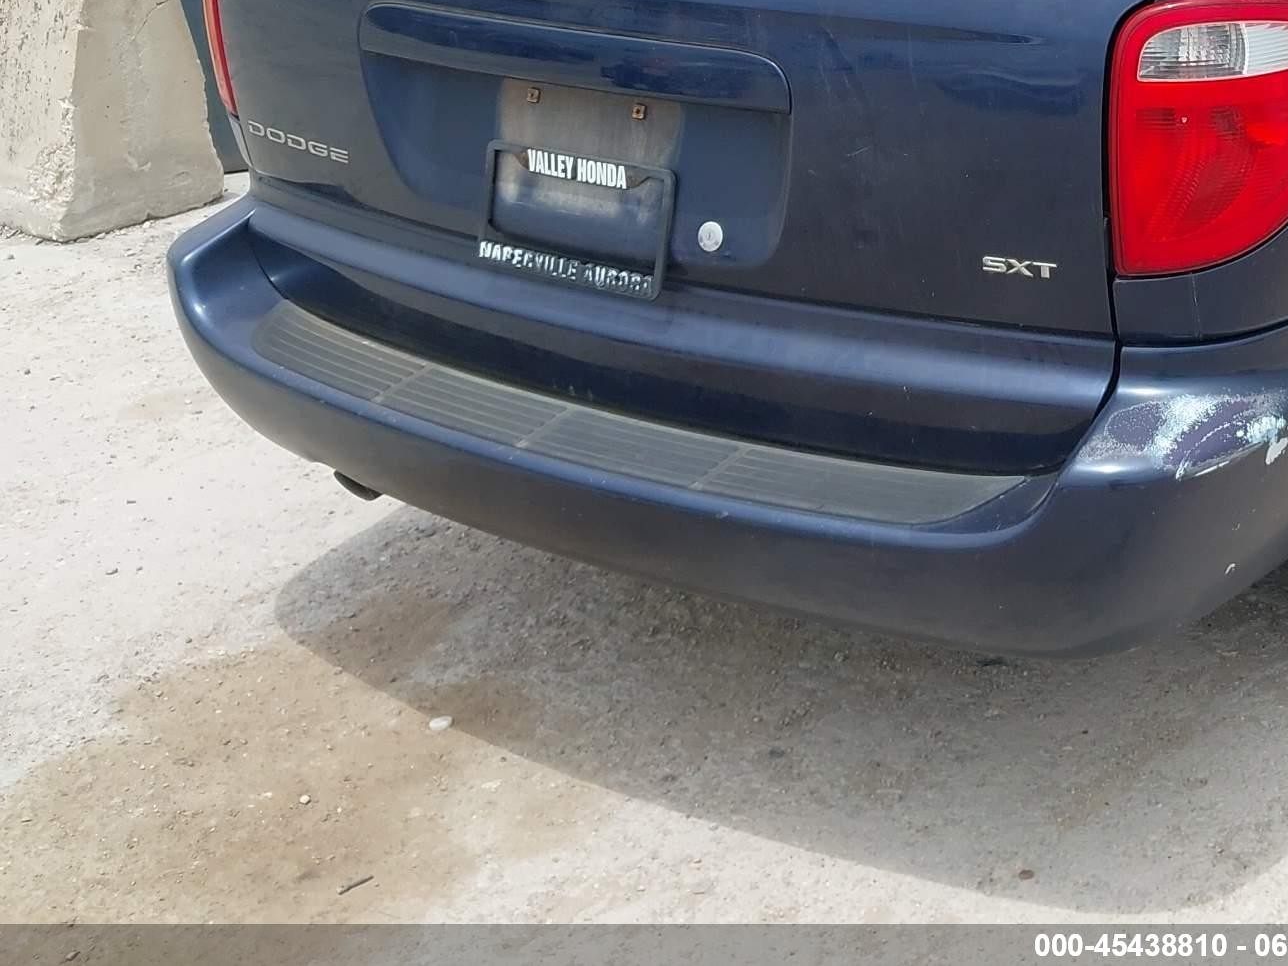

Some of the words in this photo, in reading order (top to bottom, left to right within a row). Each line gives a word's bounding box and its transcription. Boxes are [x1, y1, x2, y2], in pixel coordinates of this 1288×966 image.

[247, 119, 349, 164] DODGE
[527, 148, 574, 180] VALLEY
[577, 157, 627, 190] HONDA
[982, 255, 1058, 279] SXT
